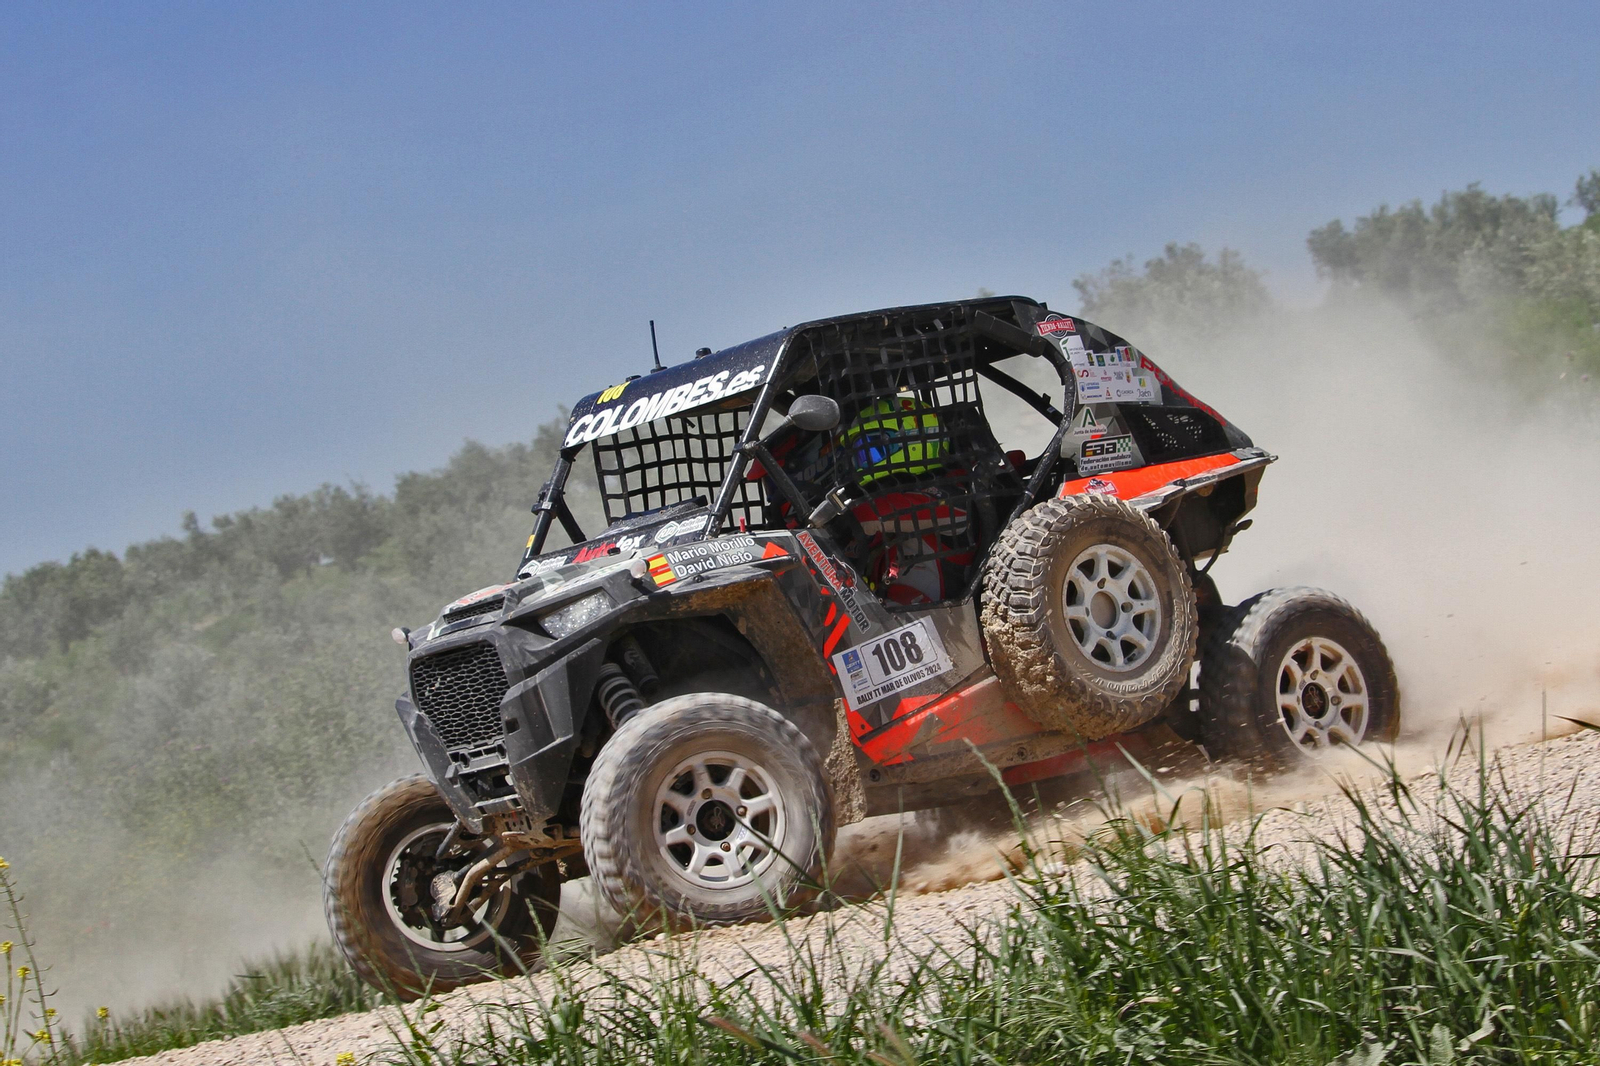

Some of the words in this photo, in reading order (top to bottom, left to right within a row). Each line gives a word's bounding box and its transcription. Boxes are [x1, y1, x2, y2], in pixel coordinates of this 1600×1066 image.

[565, 365, 765, 447] COLOMBES.es
[1081, 456, 1110, 465] Federación
[667, 545, 708, 564] Mario
[707, 536, 755, 554] Morillo
[674, 558, 716, 578] David
[719, 551, 753, 568] Nieto
[799, 532, 843, 591] AVENTURA
[840, 588, 870, 632] MOTOR
[872, 631, 924, 676] 108
[856, 689, 874, 705] RALLY
[873, 687, 882, 698] TT
[881, 682, 895, 695] MAR
[895, 679, 904, 689] DE
[904, 671, 926, 687] OLIVOS
[925, 663, 942, 677] 2024
